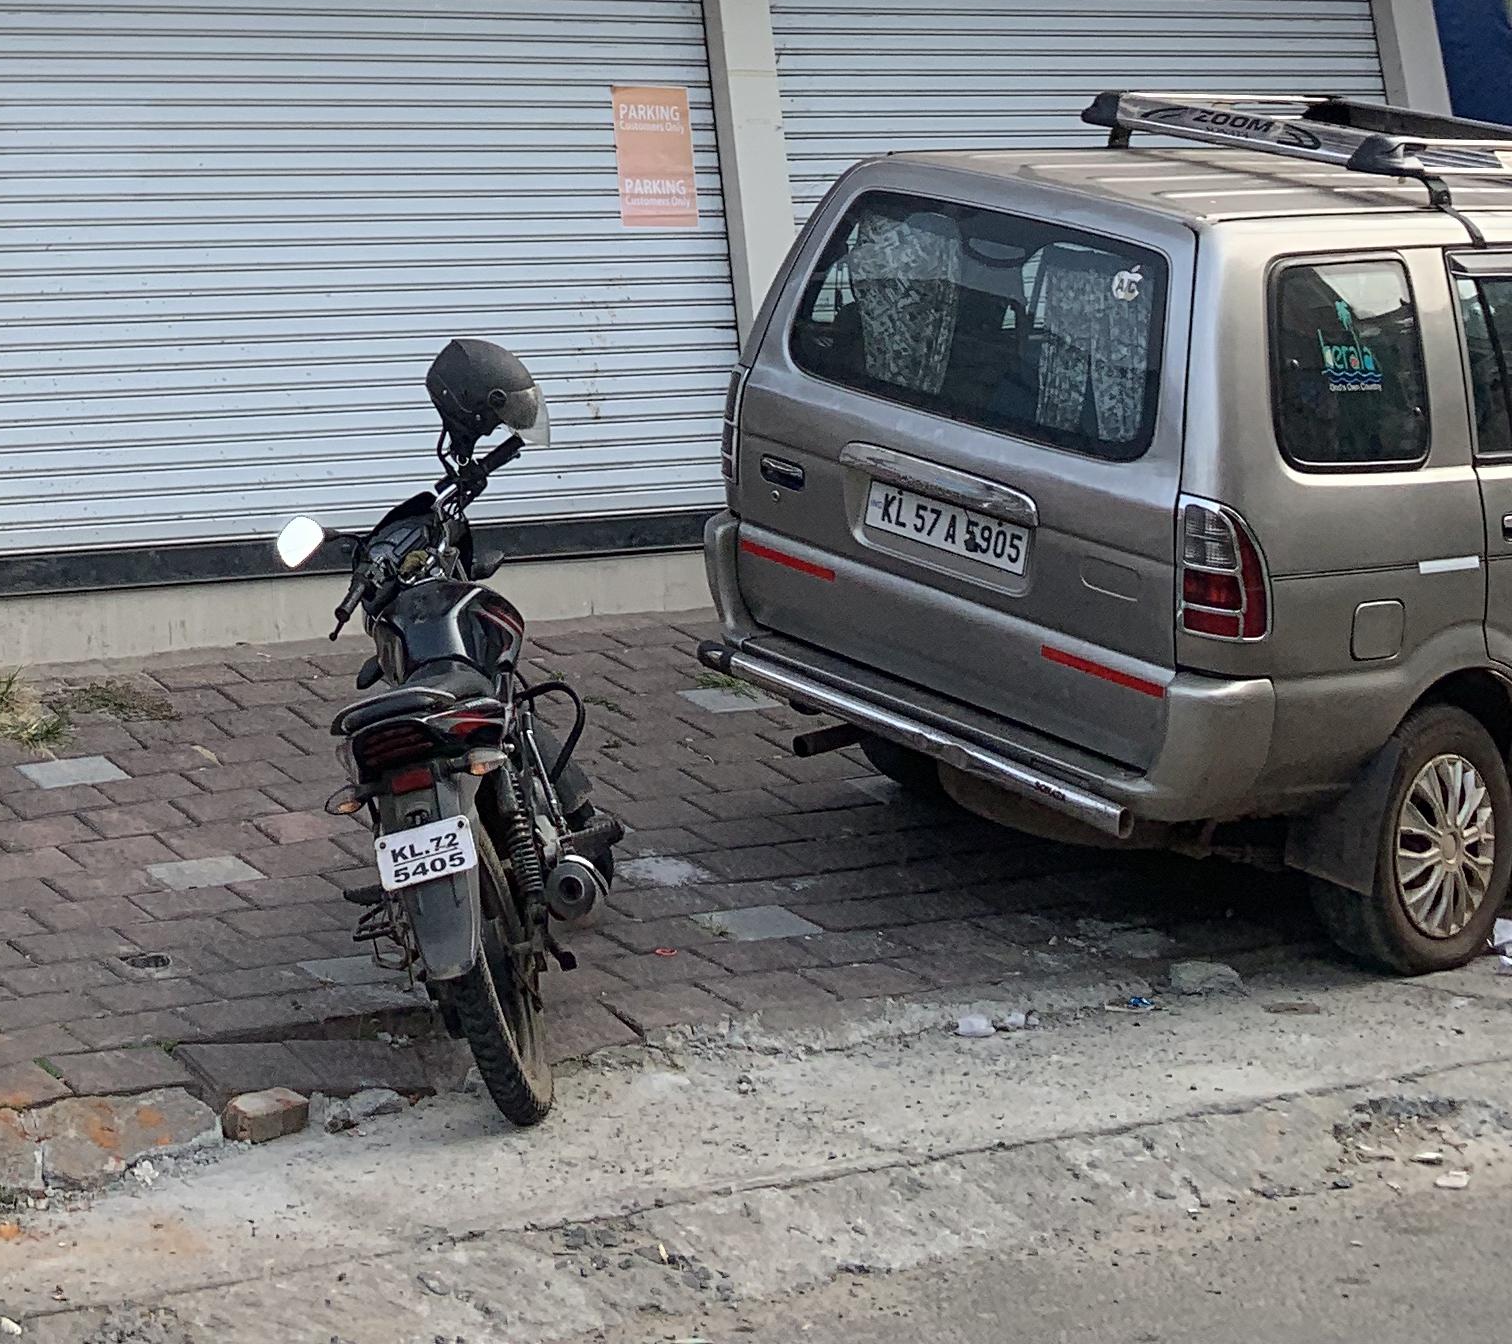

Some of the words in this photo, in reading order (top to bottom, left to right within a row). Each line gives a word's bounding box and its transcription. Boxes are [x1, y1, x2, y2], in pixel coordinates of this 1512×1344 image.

[619, 103, 680, 121] PARKING
[1192, 110, 1275, 132] ZOOM
[619, 121, 665, 131] Customers
[665, 121, 684, 134] Only
[624, 178, 686, 194] PARKING
[625, 195, 671, 206] Customers
[672, 196, 690, 208] Only
[880, 492, 907, 528] KL
[913, 503, 942, 537] 57
[944, 514, 957, 545] A
[964, 519, 1023, 564] 5905
[391, 832, 459, 863] KL.72
[394, 852, 466, 883] 5405
